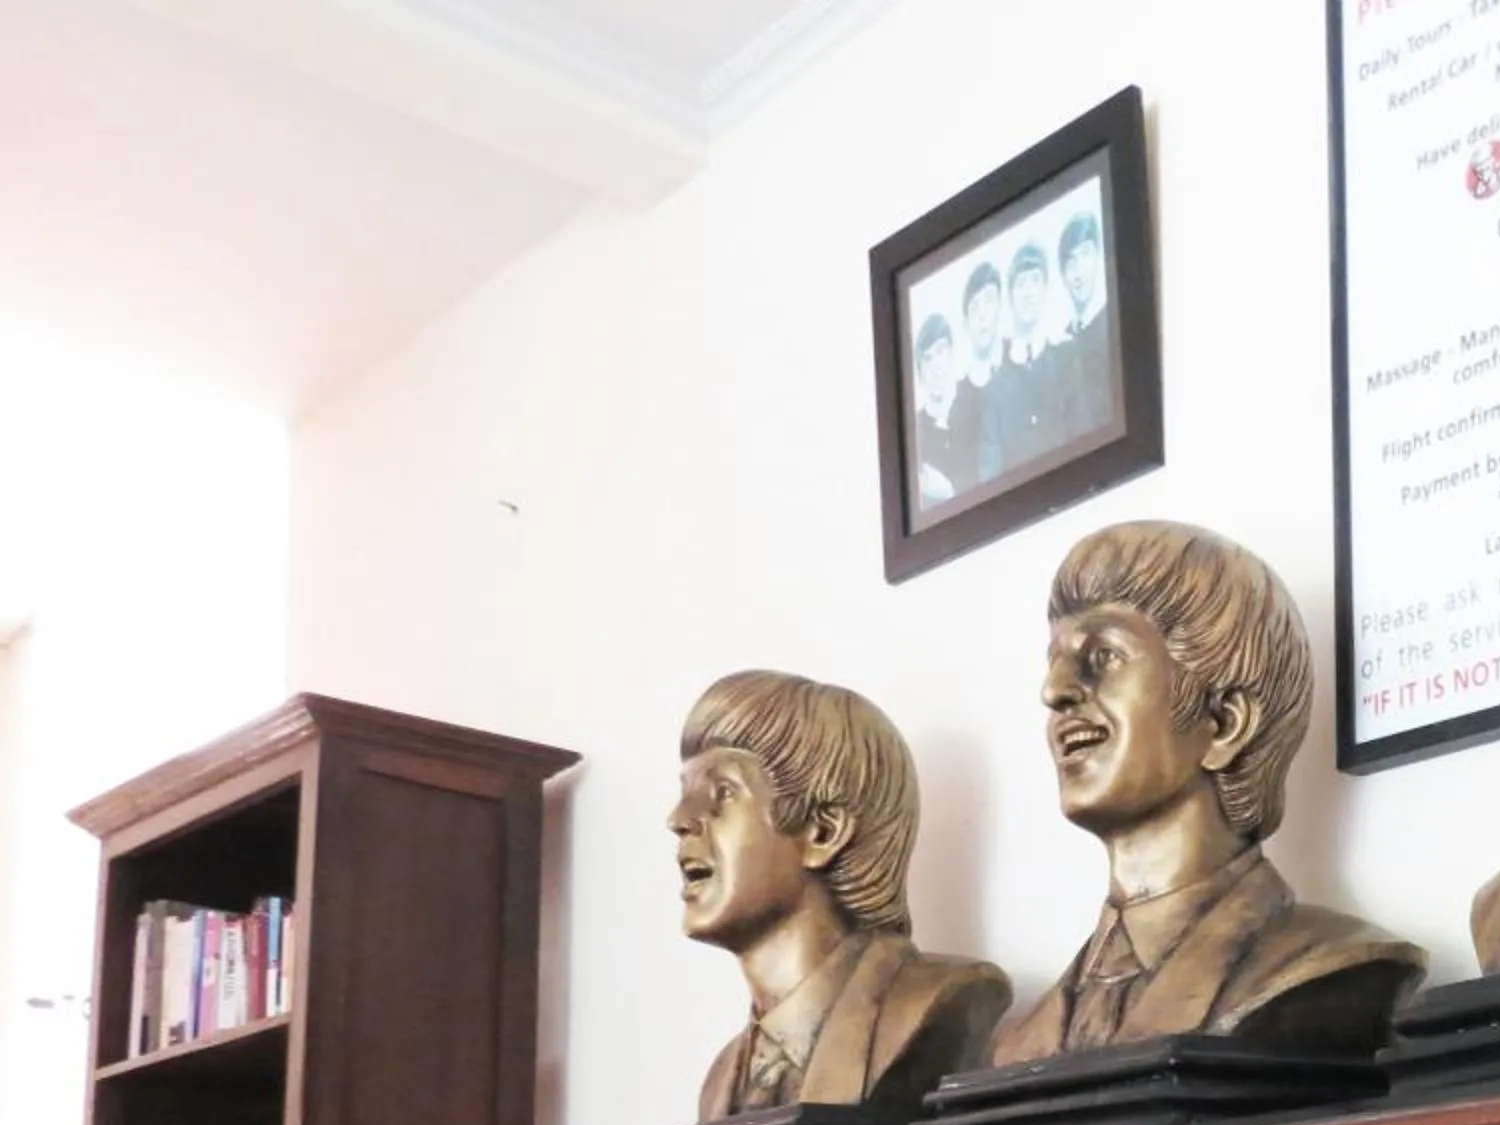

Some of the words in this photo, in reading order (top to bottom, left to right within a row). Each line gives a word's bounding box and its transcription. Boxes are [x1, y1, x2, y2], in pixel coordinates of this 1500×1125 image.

[1359, 48, 1401, 82] Daily
[1406, 20, 1453, 54] Tours
[1387, 70, 1442, 111] Rental
[1448, 51, 1478, 80] Car
[1416, 138, 1462, 172] Have
[1366, 348, 1443, 394] Massage
[1381, 429, 1432, 465] Flight
[1400, 461, 1481, 507] Payment
[1360, 600, 1429, 640] Please
[1444, 581, 1481, 613] ask
[1360, 649, 1383, 680] of
[1398, 640, 1434, 669] the
[1400, 682, 1418, 709] IT
[1426, 674, 1445, 701] IS
